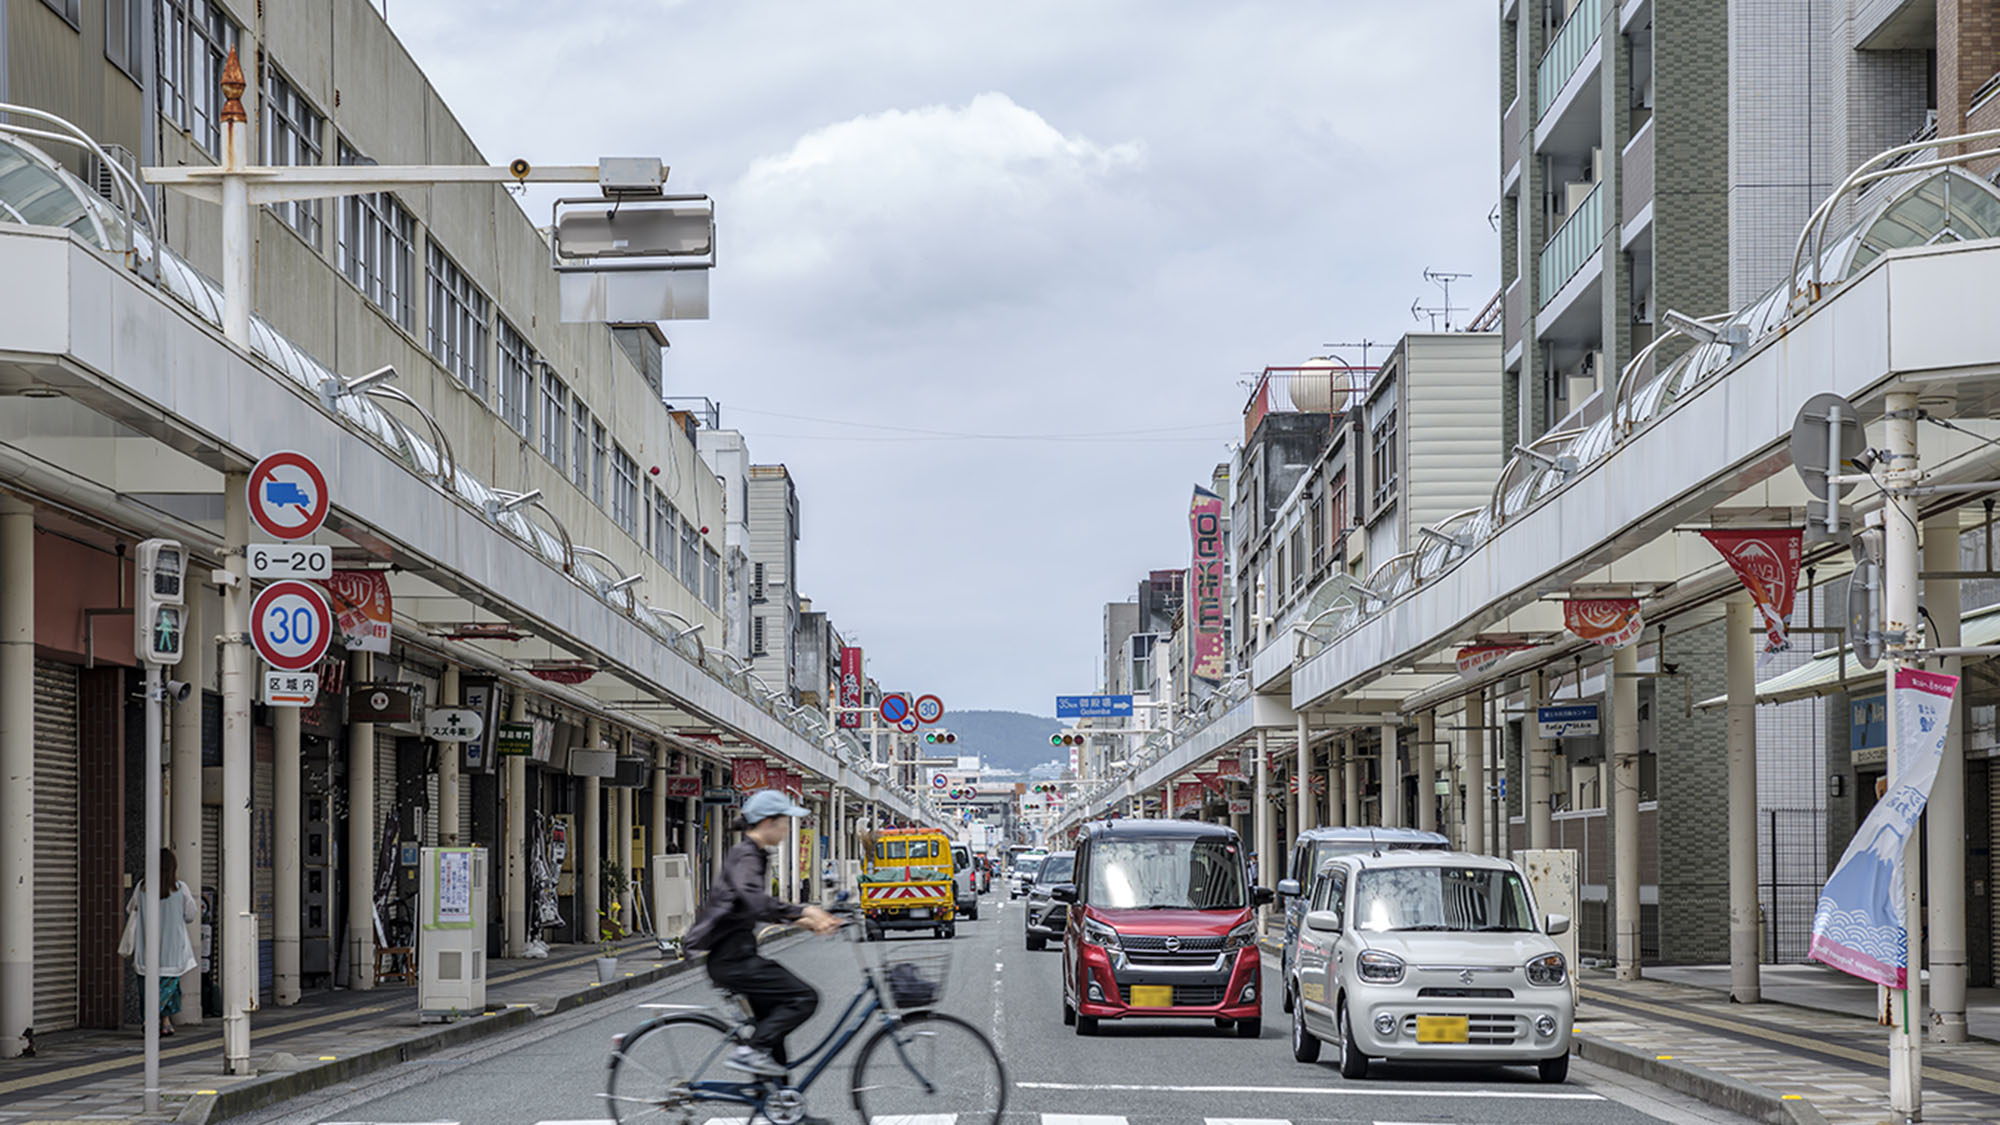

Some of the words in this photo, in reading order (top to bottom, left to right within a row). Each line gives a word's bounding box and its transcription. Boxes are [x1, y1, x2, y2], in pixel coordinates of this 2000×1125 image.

[269, 606, 313, 646] 30
[268, 678, 316, 692] 区域内
[920, 702, 938, 718] 30
